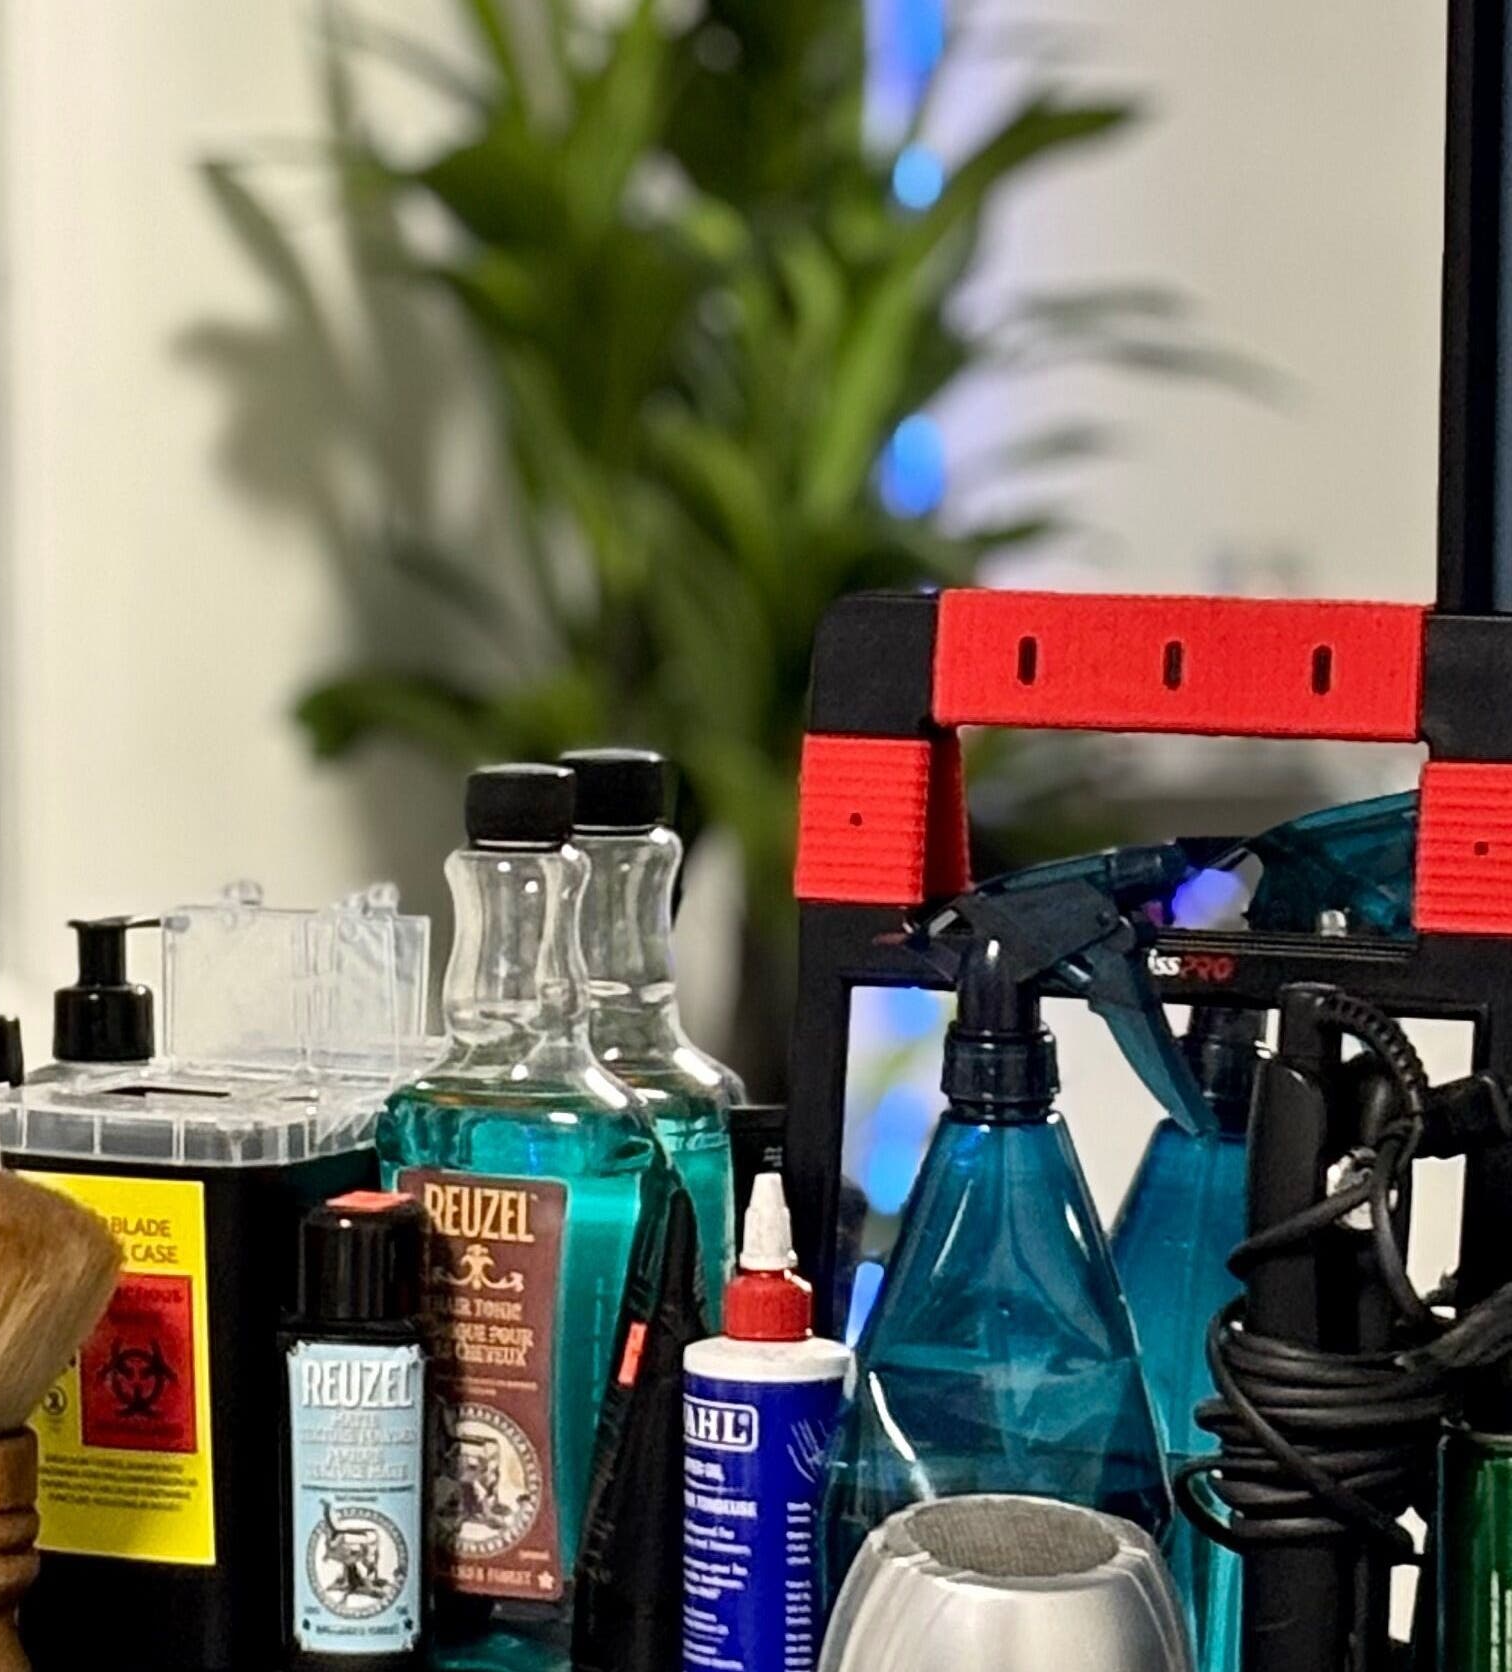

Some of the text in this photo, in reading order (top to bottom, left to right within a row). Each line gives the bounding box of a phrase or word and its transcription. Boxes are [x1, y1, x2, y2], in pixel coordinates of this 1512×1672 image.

[1147, 948, 1235, 982] issPRO
[111, 1216, 172, 1238] BLADE
[424, 1183, 536, 1243] REUZEL
[131, 1244, 179, 1264] CASE
[302, 1360, 415, 1410] REUZEL
[684, 1401, 748, 1444] AHL
